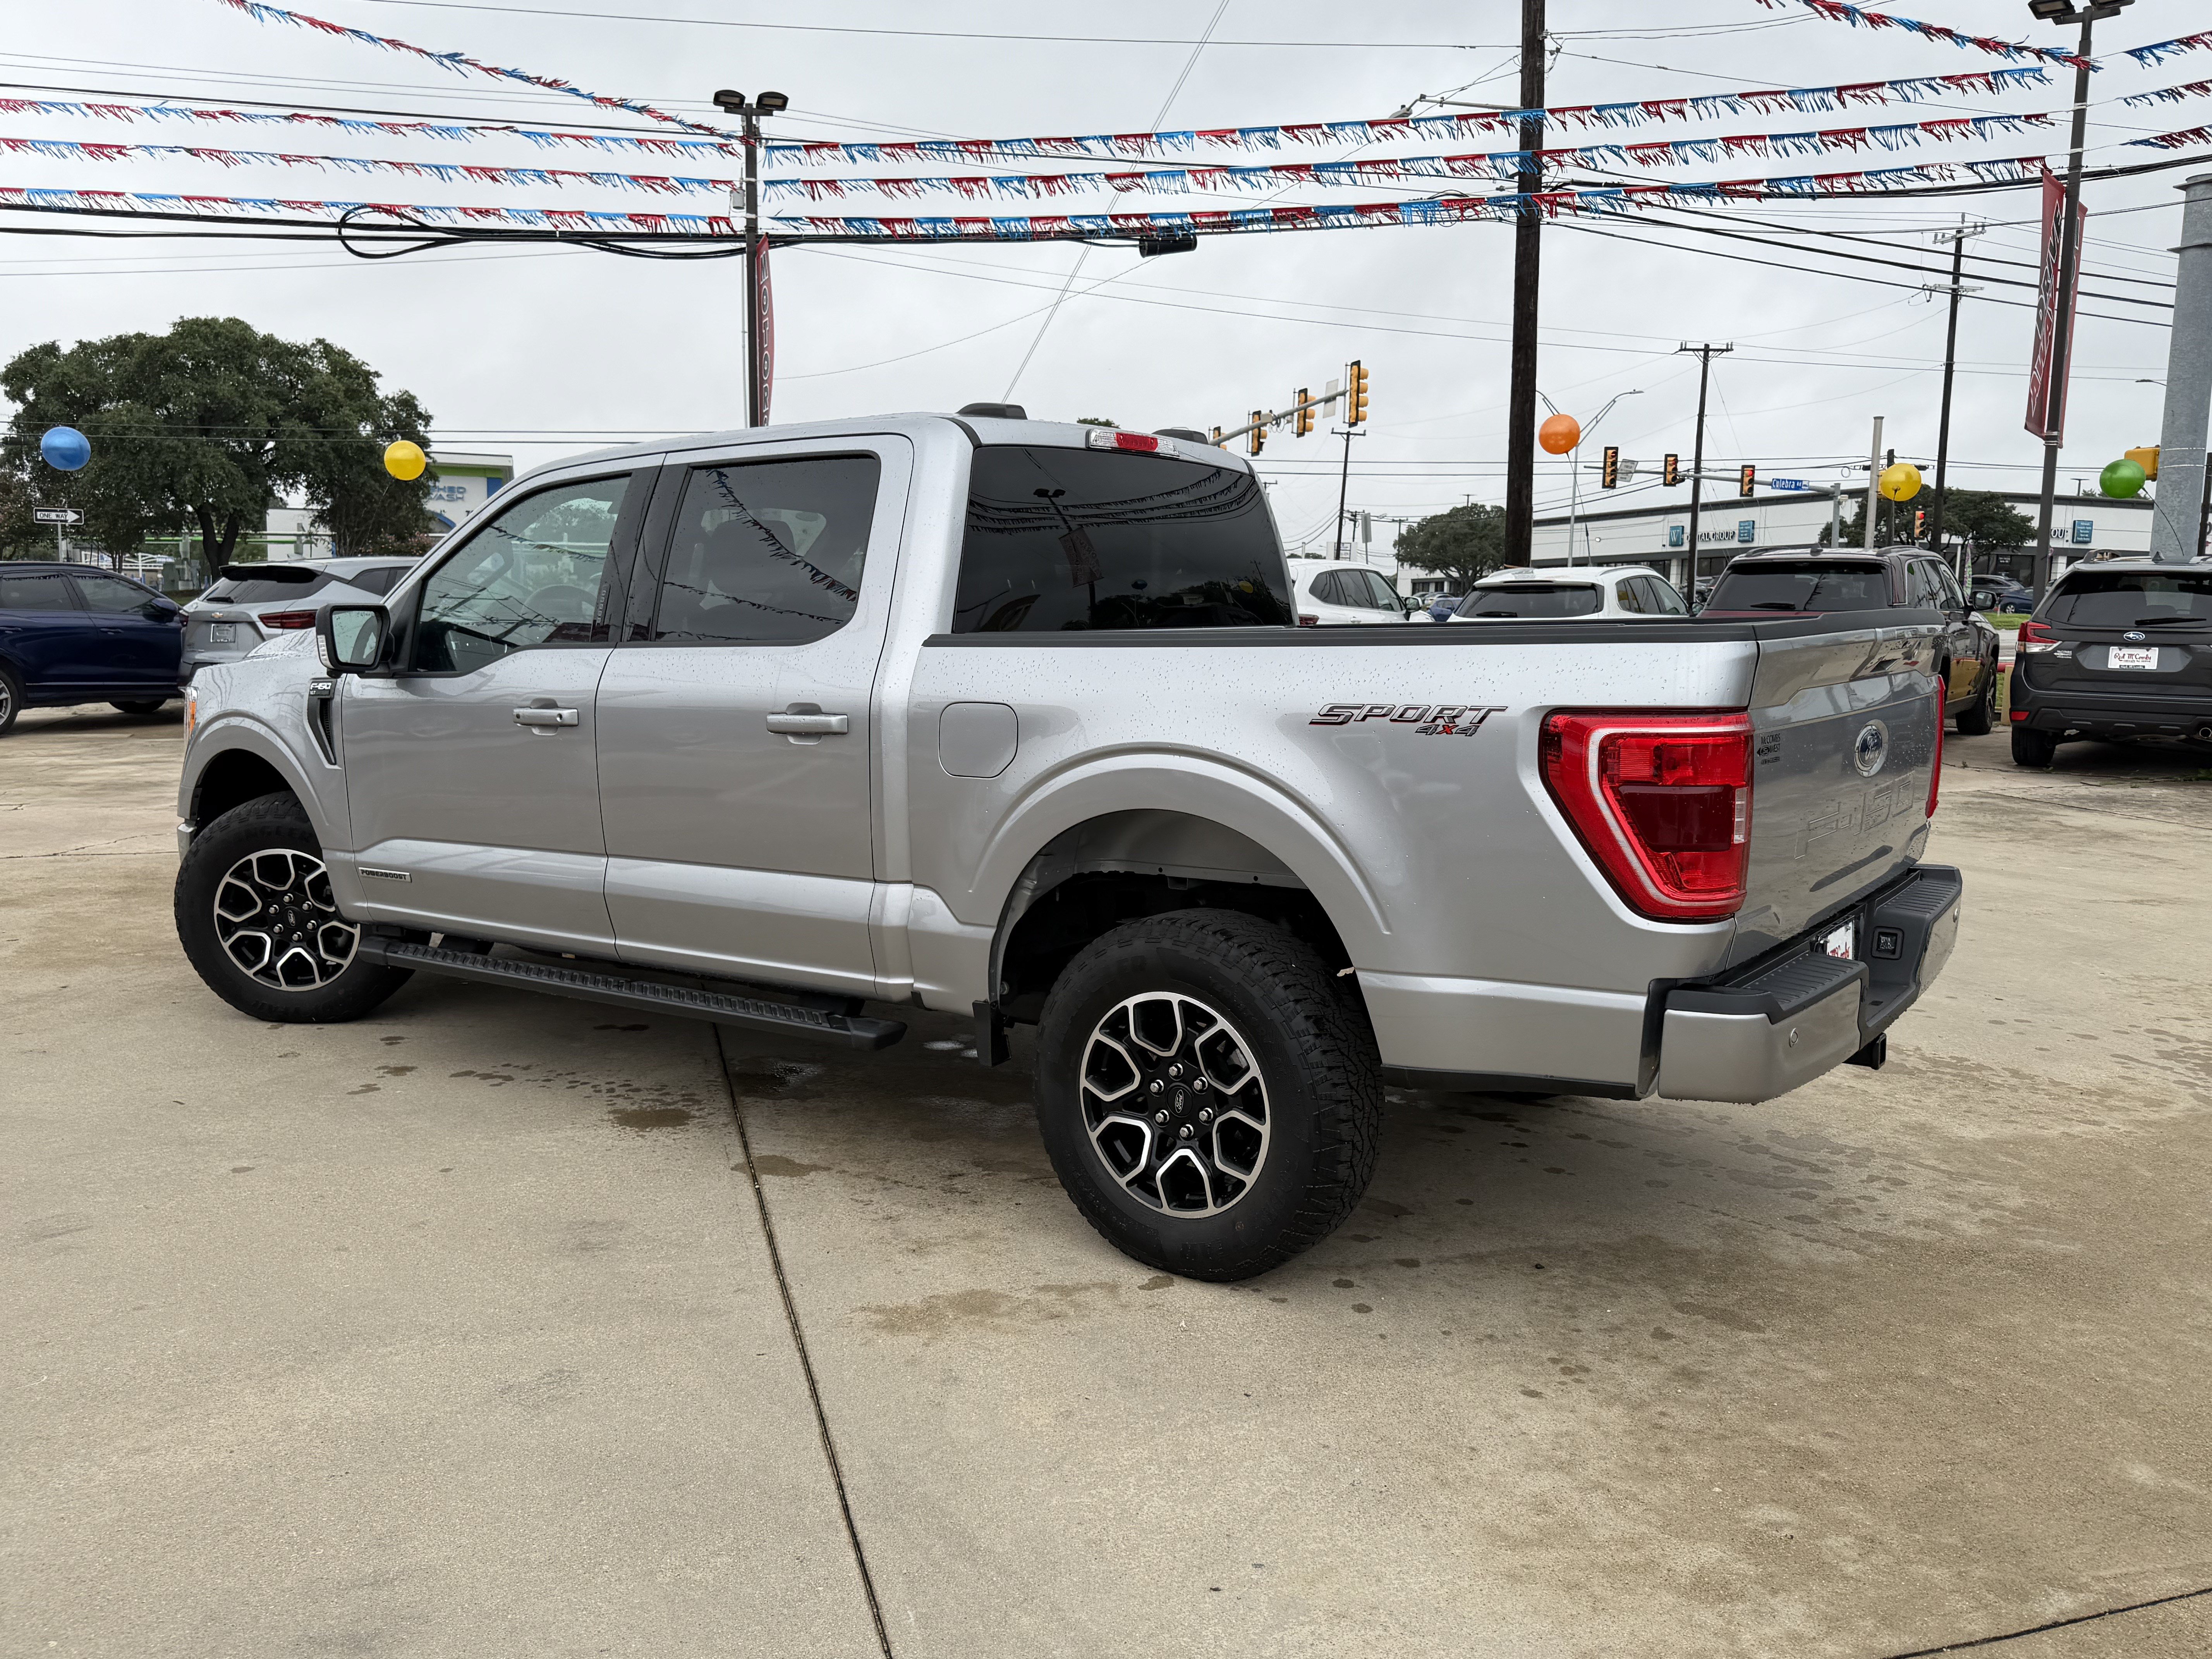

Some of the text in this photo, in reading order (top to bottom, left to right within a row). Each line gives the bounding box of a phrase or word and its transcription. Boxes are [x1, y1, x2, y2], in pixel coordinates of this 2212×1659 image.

[1772, 479, 1795, 489] Culebra
[1686, 533, 1709, 541] DTAL
[1309, 703, 1509, 725] SPORT
[361, 869, 407, 880] POWERBOOST
